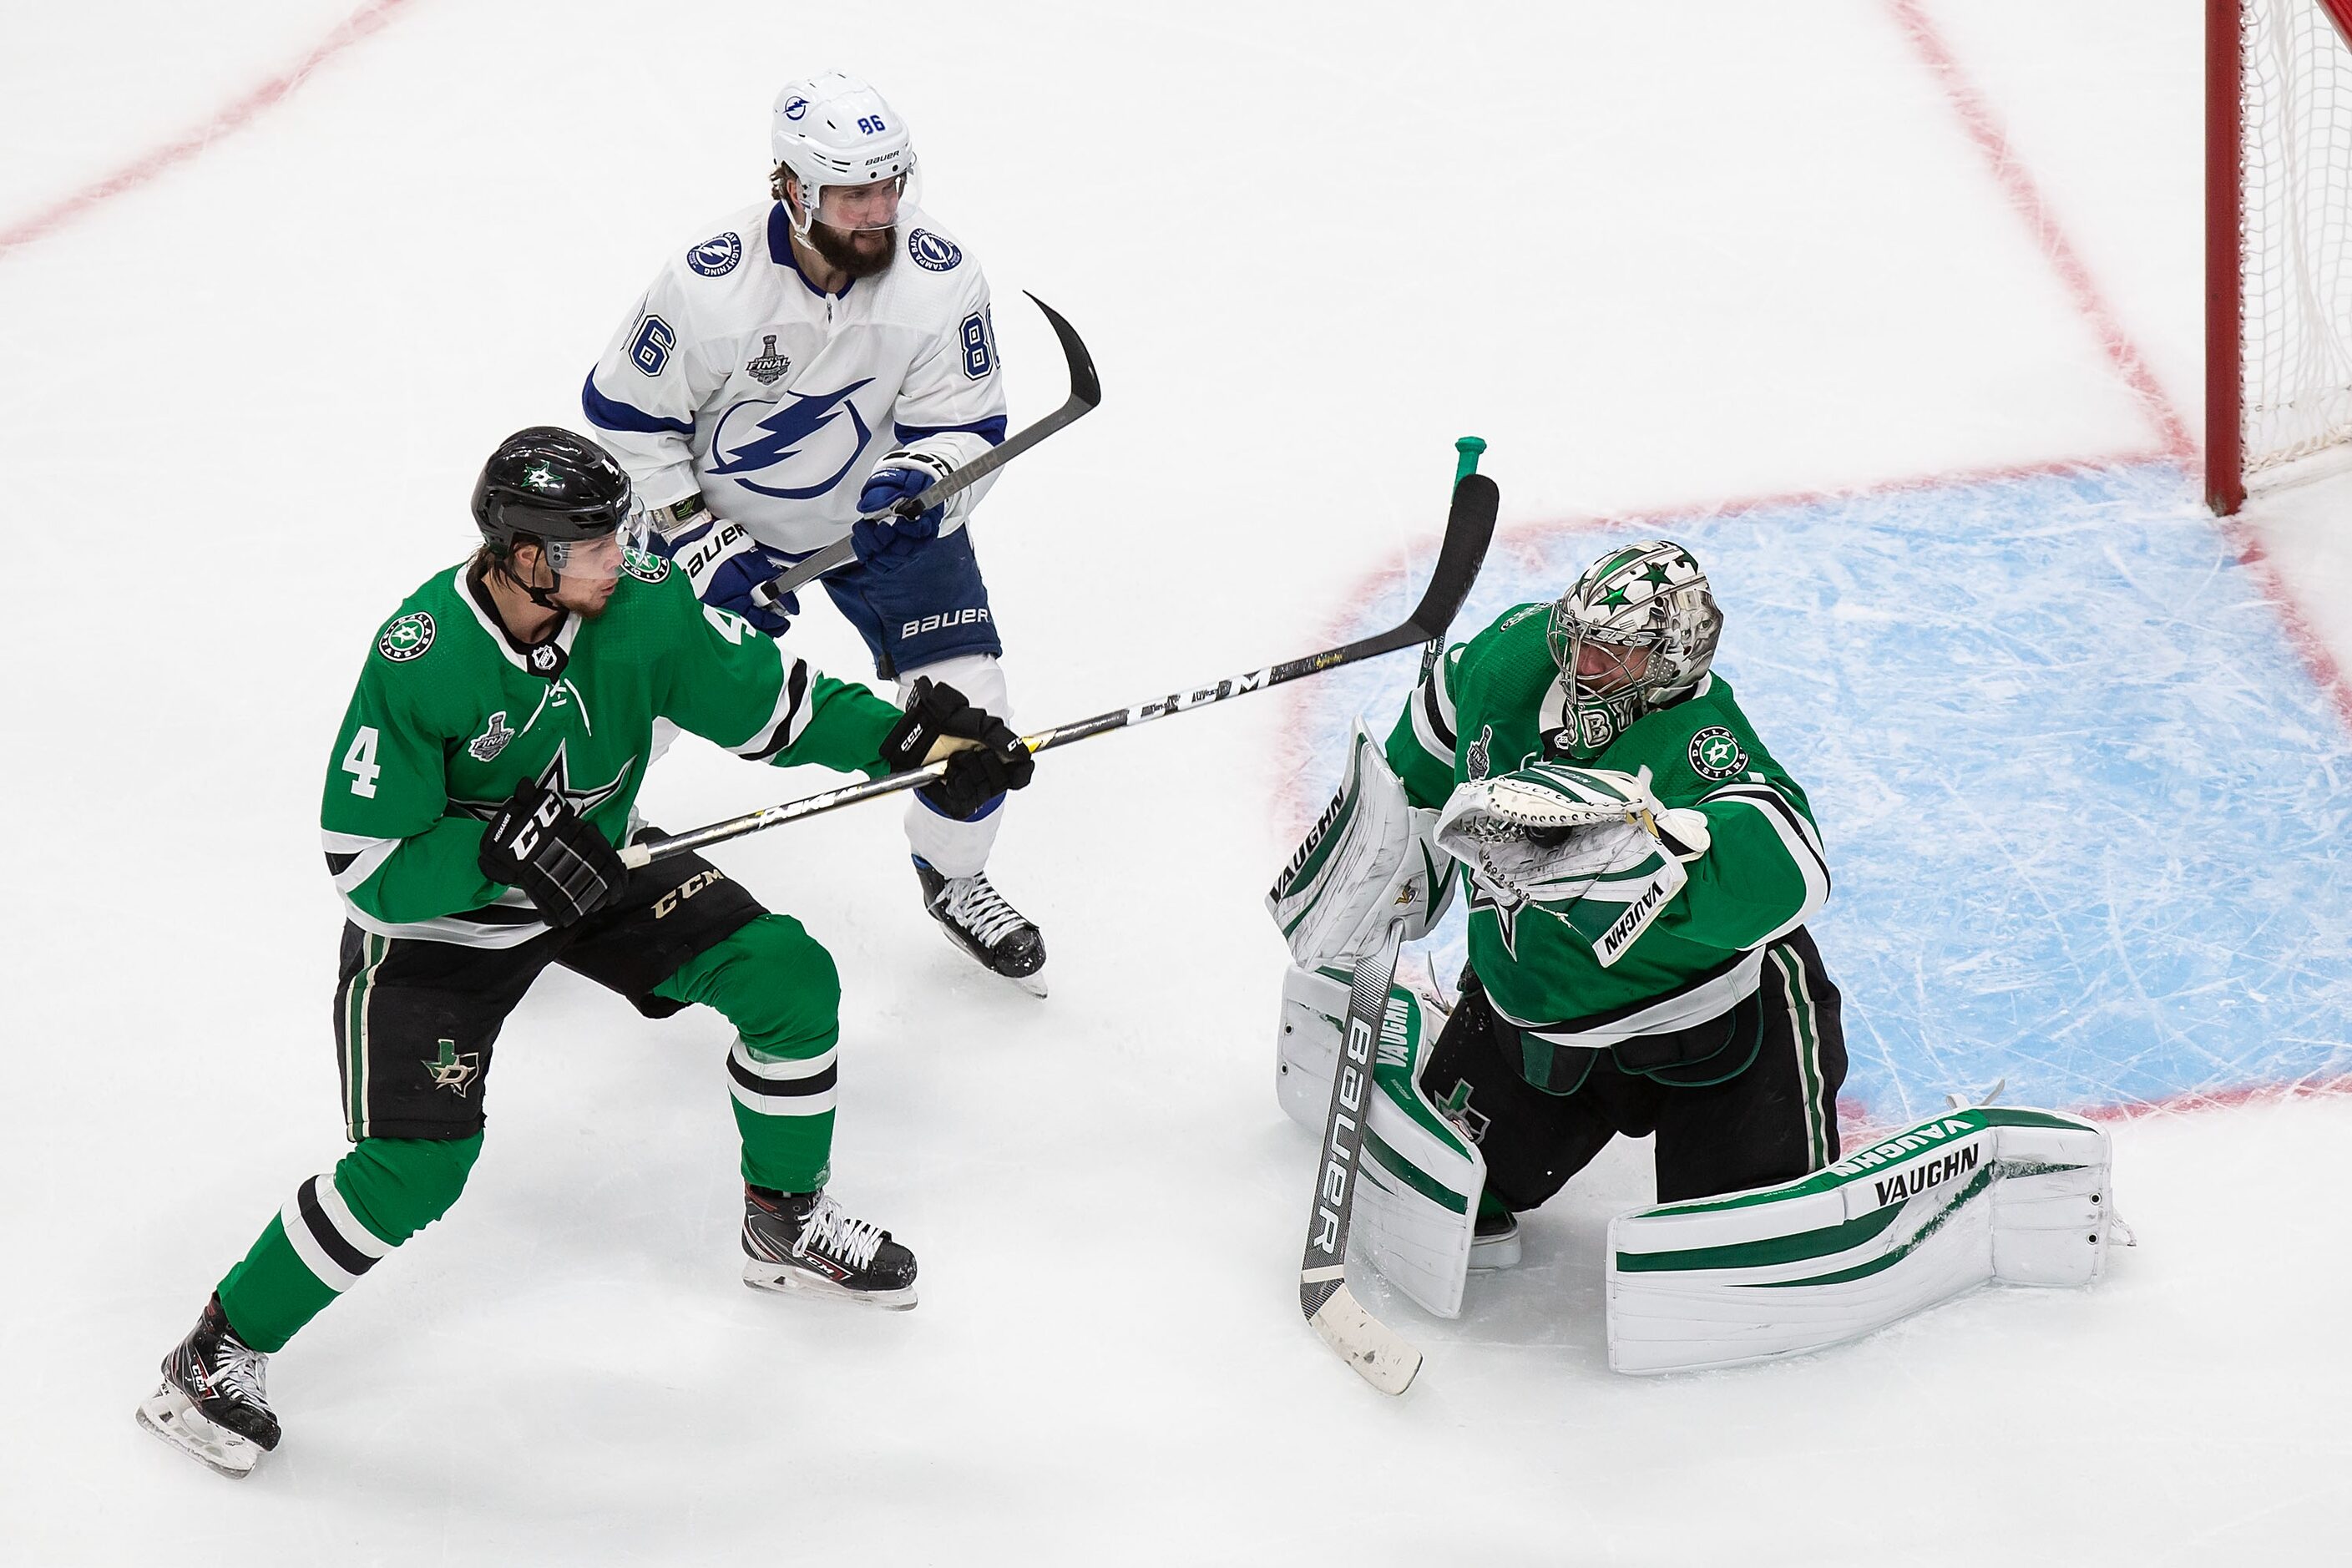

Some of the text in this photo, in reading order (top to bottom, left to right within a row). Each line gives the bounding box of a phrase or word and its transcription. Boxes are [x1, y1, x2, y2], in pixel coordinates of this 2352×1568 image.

[857, 114, 886, 135] 86
[865, 150, 900, 166] BAUER
[704, 244, 740, 276] LIGHTNING
[910, 237, 918, 253] BAY
[915, 253, 943, 270] TAMPA
[622, 302, 677, 377] 6
[959, 303, 1000, 381] 8
[748, 359, 791, 370] FINAL
[703, 603, 757, 646] 4
[900, 606, 989, 640] BAUER
[900, 722, 922, 751] CCM
[1469, 746, 1488, 770] FINAL
[341, 725, 381, 799] 4
[1702, 753, 1746, 777] STARS
[508, 792, 562, 861] CC
[1269, 785, 1345, 905] VAUGHN
[650, 868, 725, 919] CCM
[1604, 880, 1665, 956] VAUGHN
[1375, 997, 1409, 1068] VAUGHN
[1313, 1017, 1372, 1255] BAUER
[1829, 1119, 1975, 1177] VAUGHN
[1875, 1143, 1980, 1207] VAUGHN
